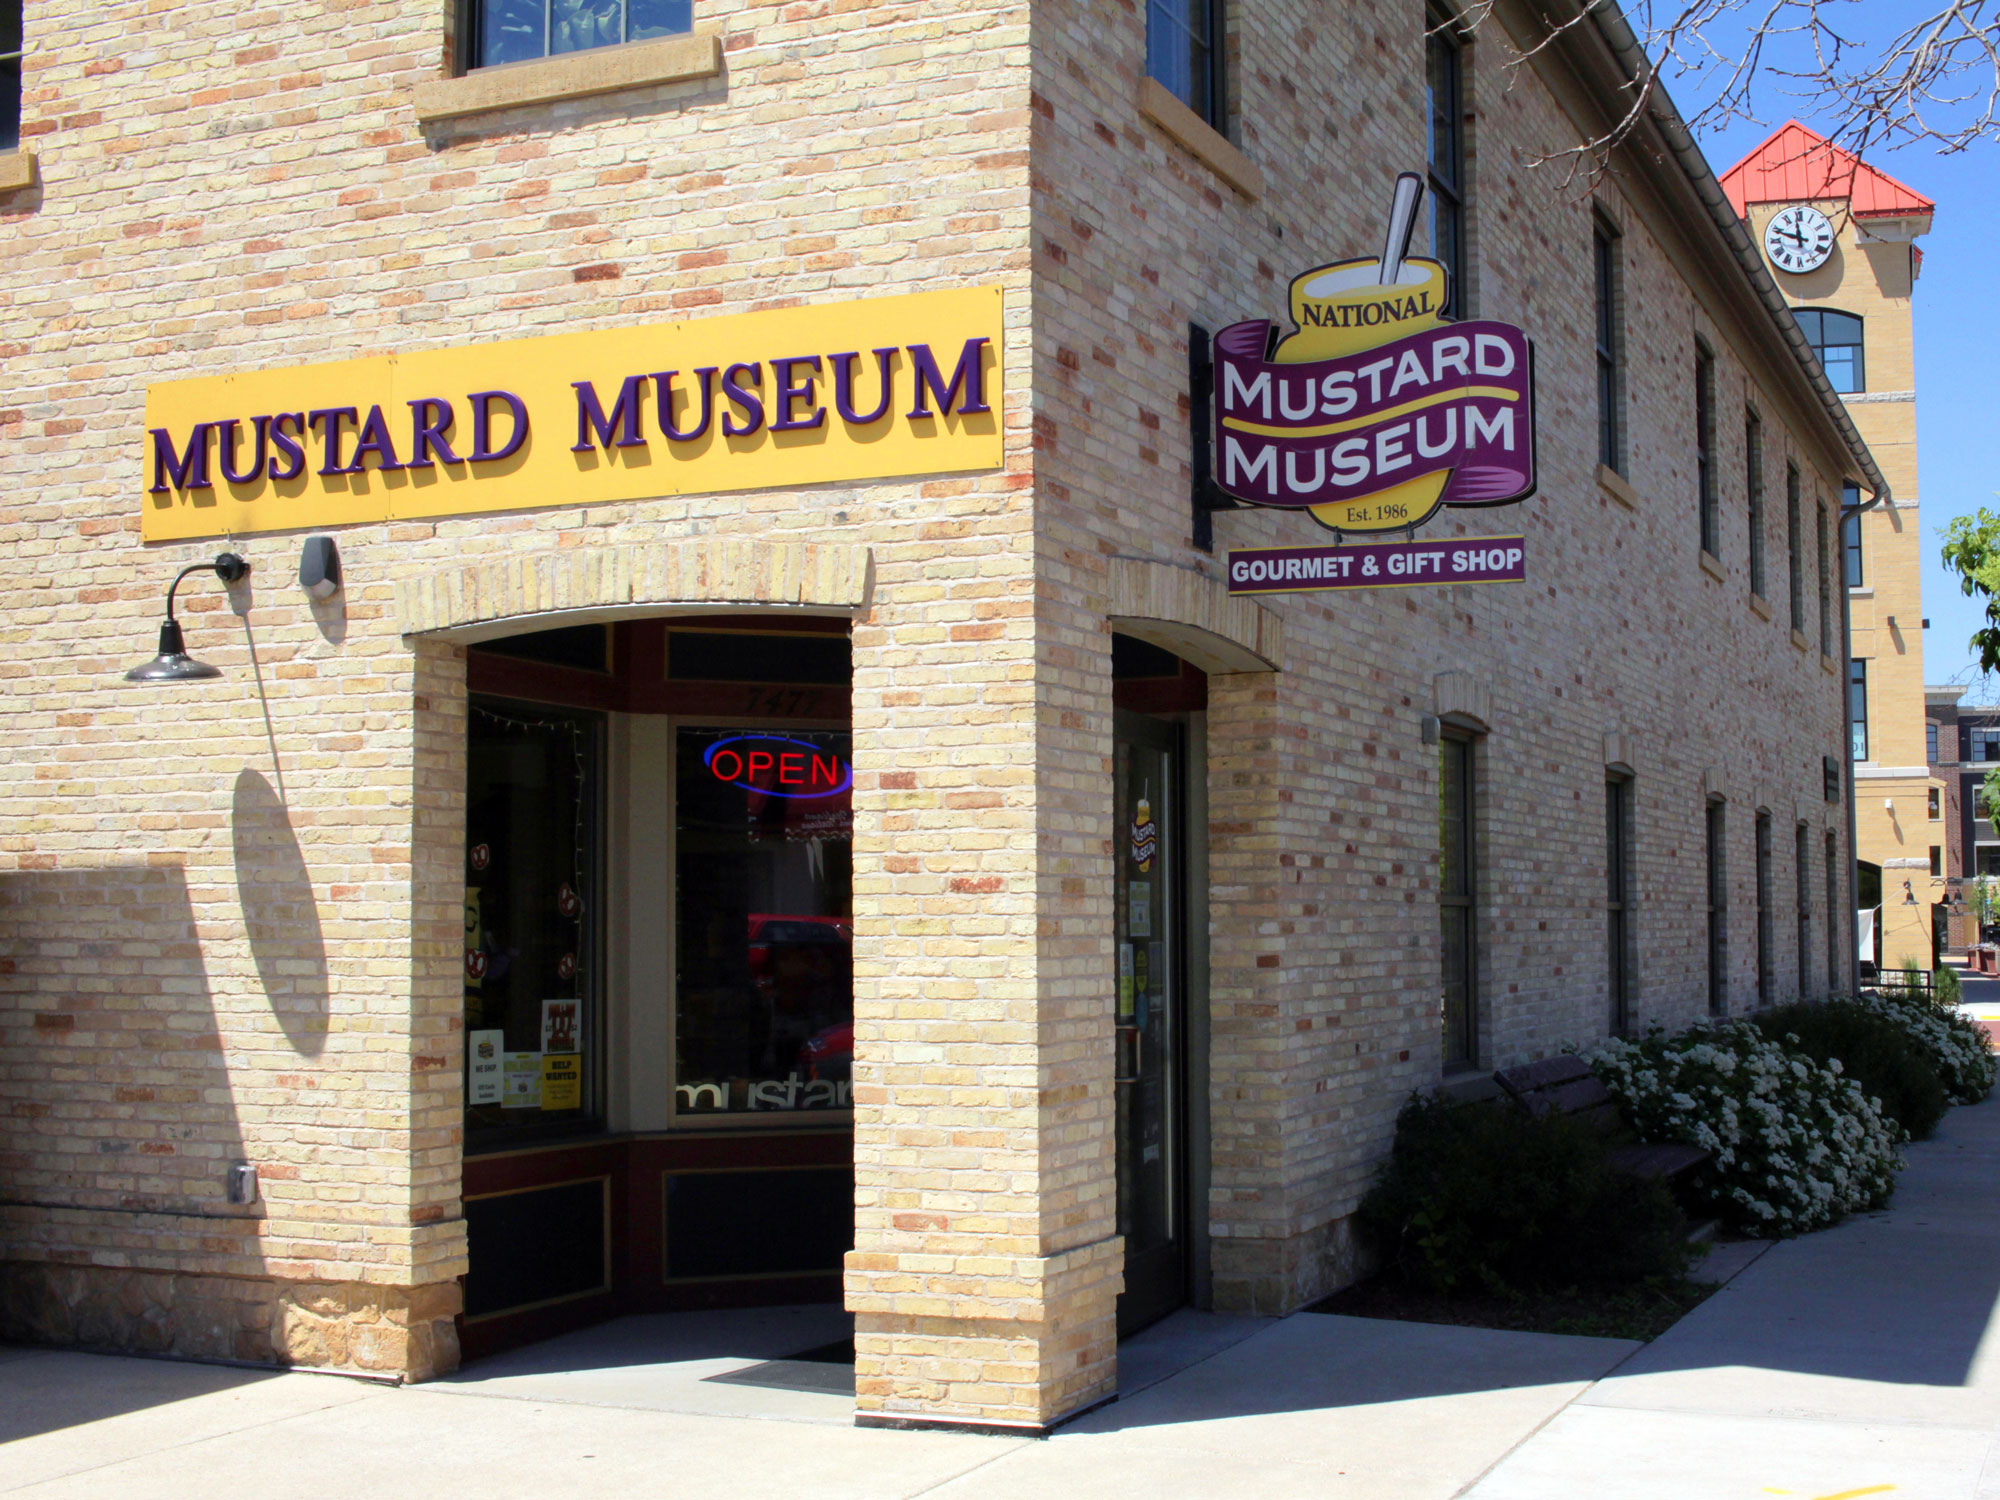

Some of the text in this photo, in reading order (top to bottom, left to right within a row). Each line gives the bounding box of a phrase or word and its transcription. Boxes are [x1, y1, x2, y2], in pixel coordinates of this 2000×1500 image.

[1302, 290, 1435, 327] NATIONAL
[1224, 334, 1516, 420] MUSTARD
[148, 336, 990, 494] MUSTARD MUSEUM
[1225, 405, 1515, 495] MUSEUM
[1347, 503, 1408, 522] Est. 1986
[1232, 548, 1522, 582] GOURMET & GIFT SHOP
[711, 750, 837, 785] OPEN
[1131, 821, 1155, 842] MUSTARD
[1131, 841, 1156, 862] MUSEUM
[545, 1072, 577, 1081] WANTED
[552, 1060, 572, 1070] HELP
